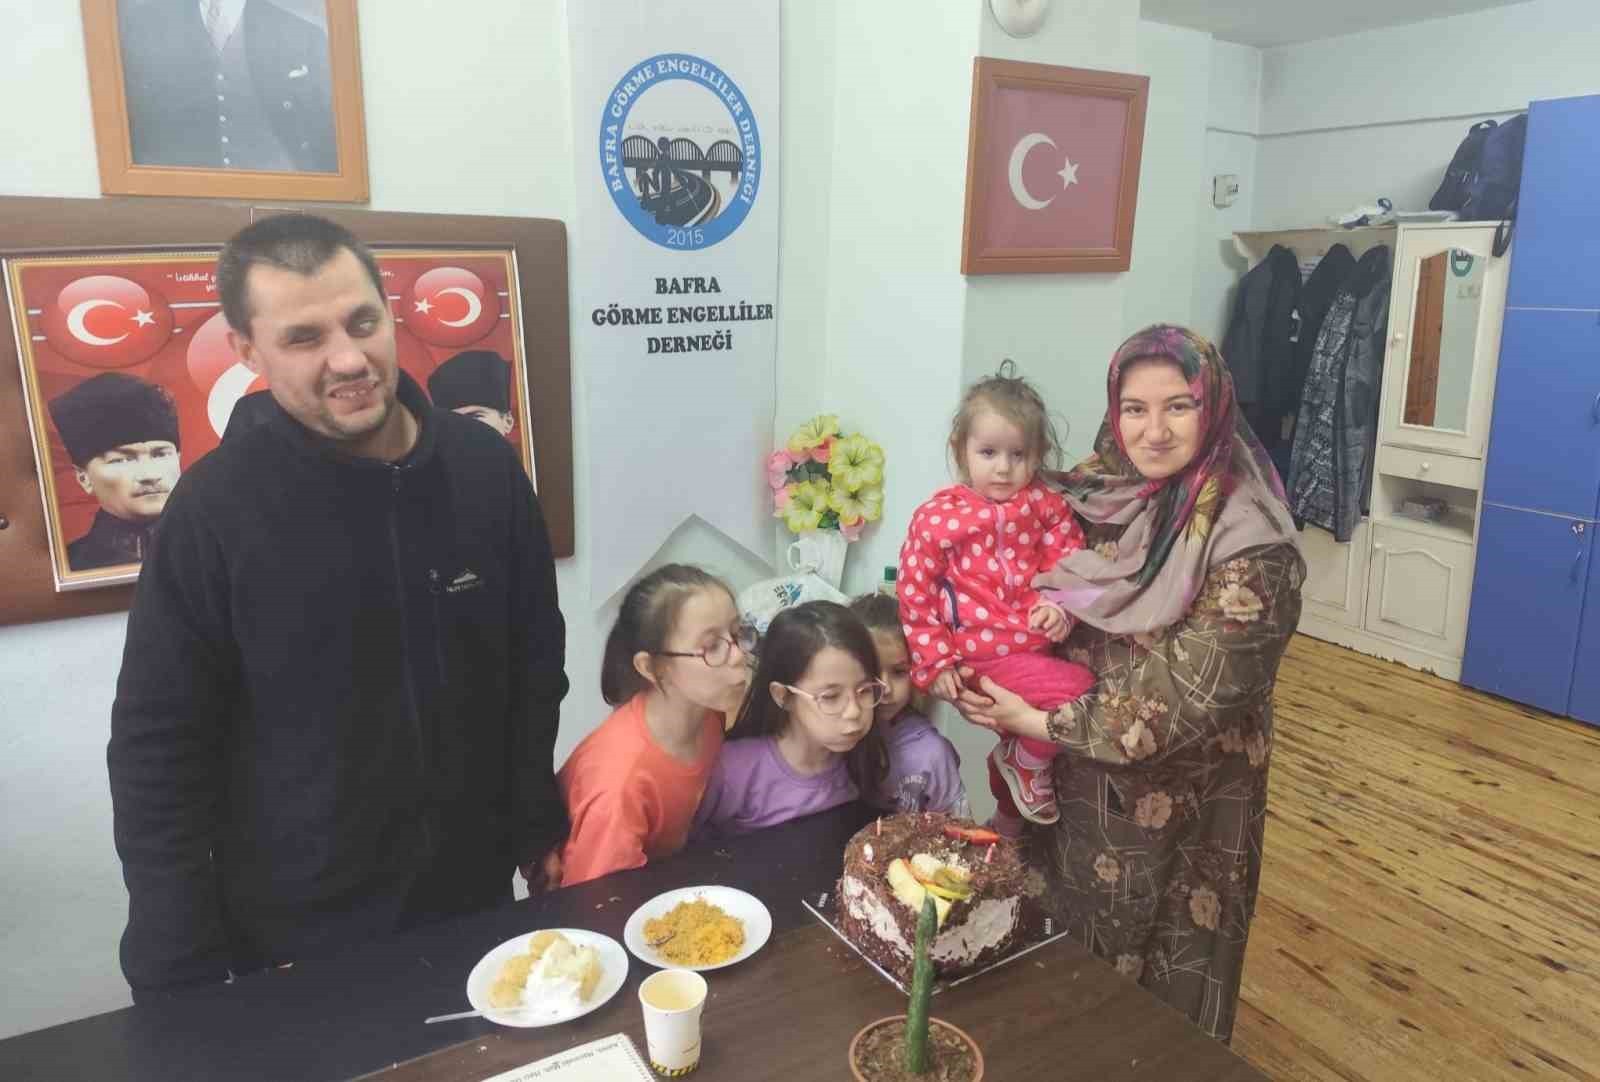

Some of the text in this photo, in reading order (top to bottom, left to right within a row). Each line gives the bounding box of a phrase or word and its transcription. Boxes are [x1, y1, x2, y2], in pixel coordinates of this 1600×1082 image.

[612, 66, 655, 117] GÖRME
[656, 59, 743, 116] ENGELLİLER
[605, 123, 624, 191] BAFRA
[667, 228, 704, 247] 2015
[655, 276, 721, 295] BAFRA
[591, 300, 774, 326] GÖRME ENGELLİLER
[647, 329, 733, 354] DERNEĞİ
